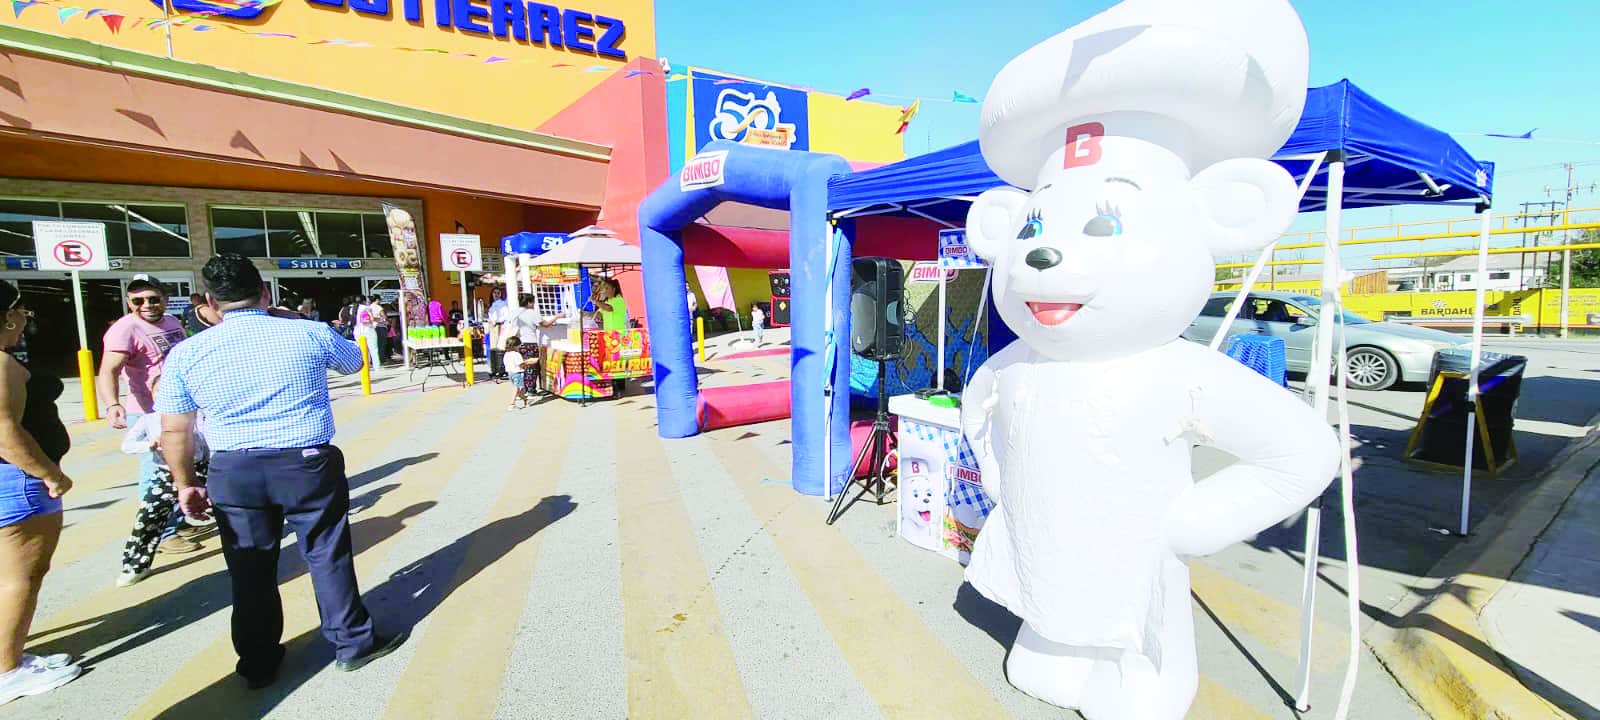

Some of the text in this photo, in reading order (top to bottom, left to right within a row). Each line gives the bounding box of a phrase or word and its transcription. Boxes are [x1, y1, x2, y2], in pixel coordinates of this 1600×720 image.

[1063, 122, 1104, 169] B
[682, 158, 721, 182] BIMBO
[945, 246, 968, 255] BIMBO
[291, 260, 337, 269] Salida
[913, 265, 956, 279] BIMO
[911, 461, 920, 473] B
